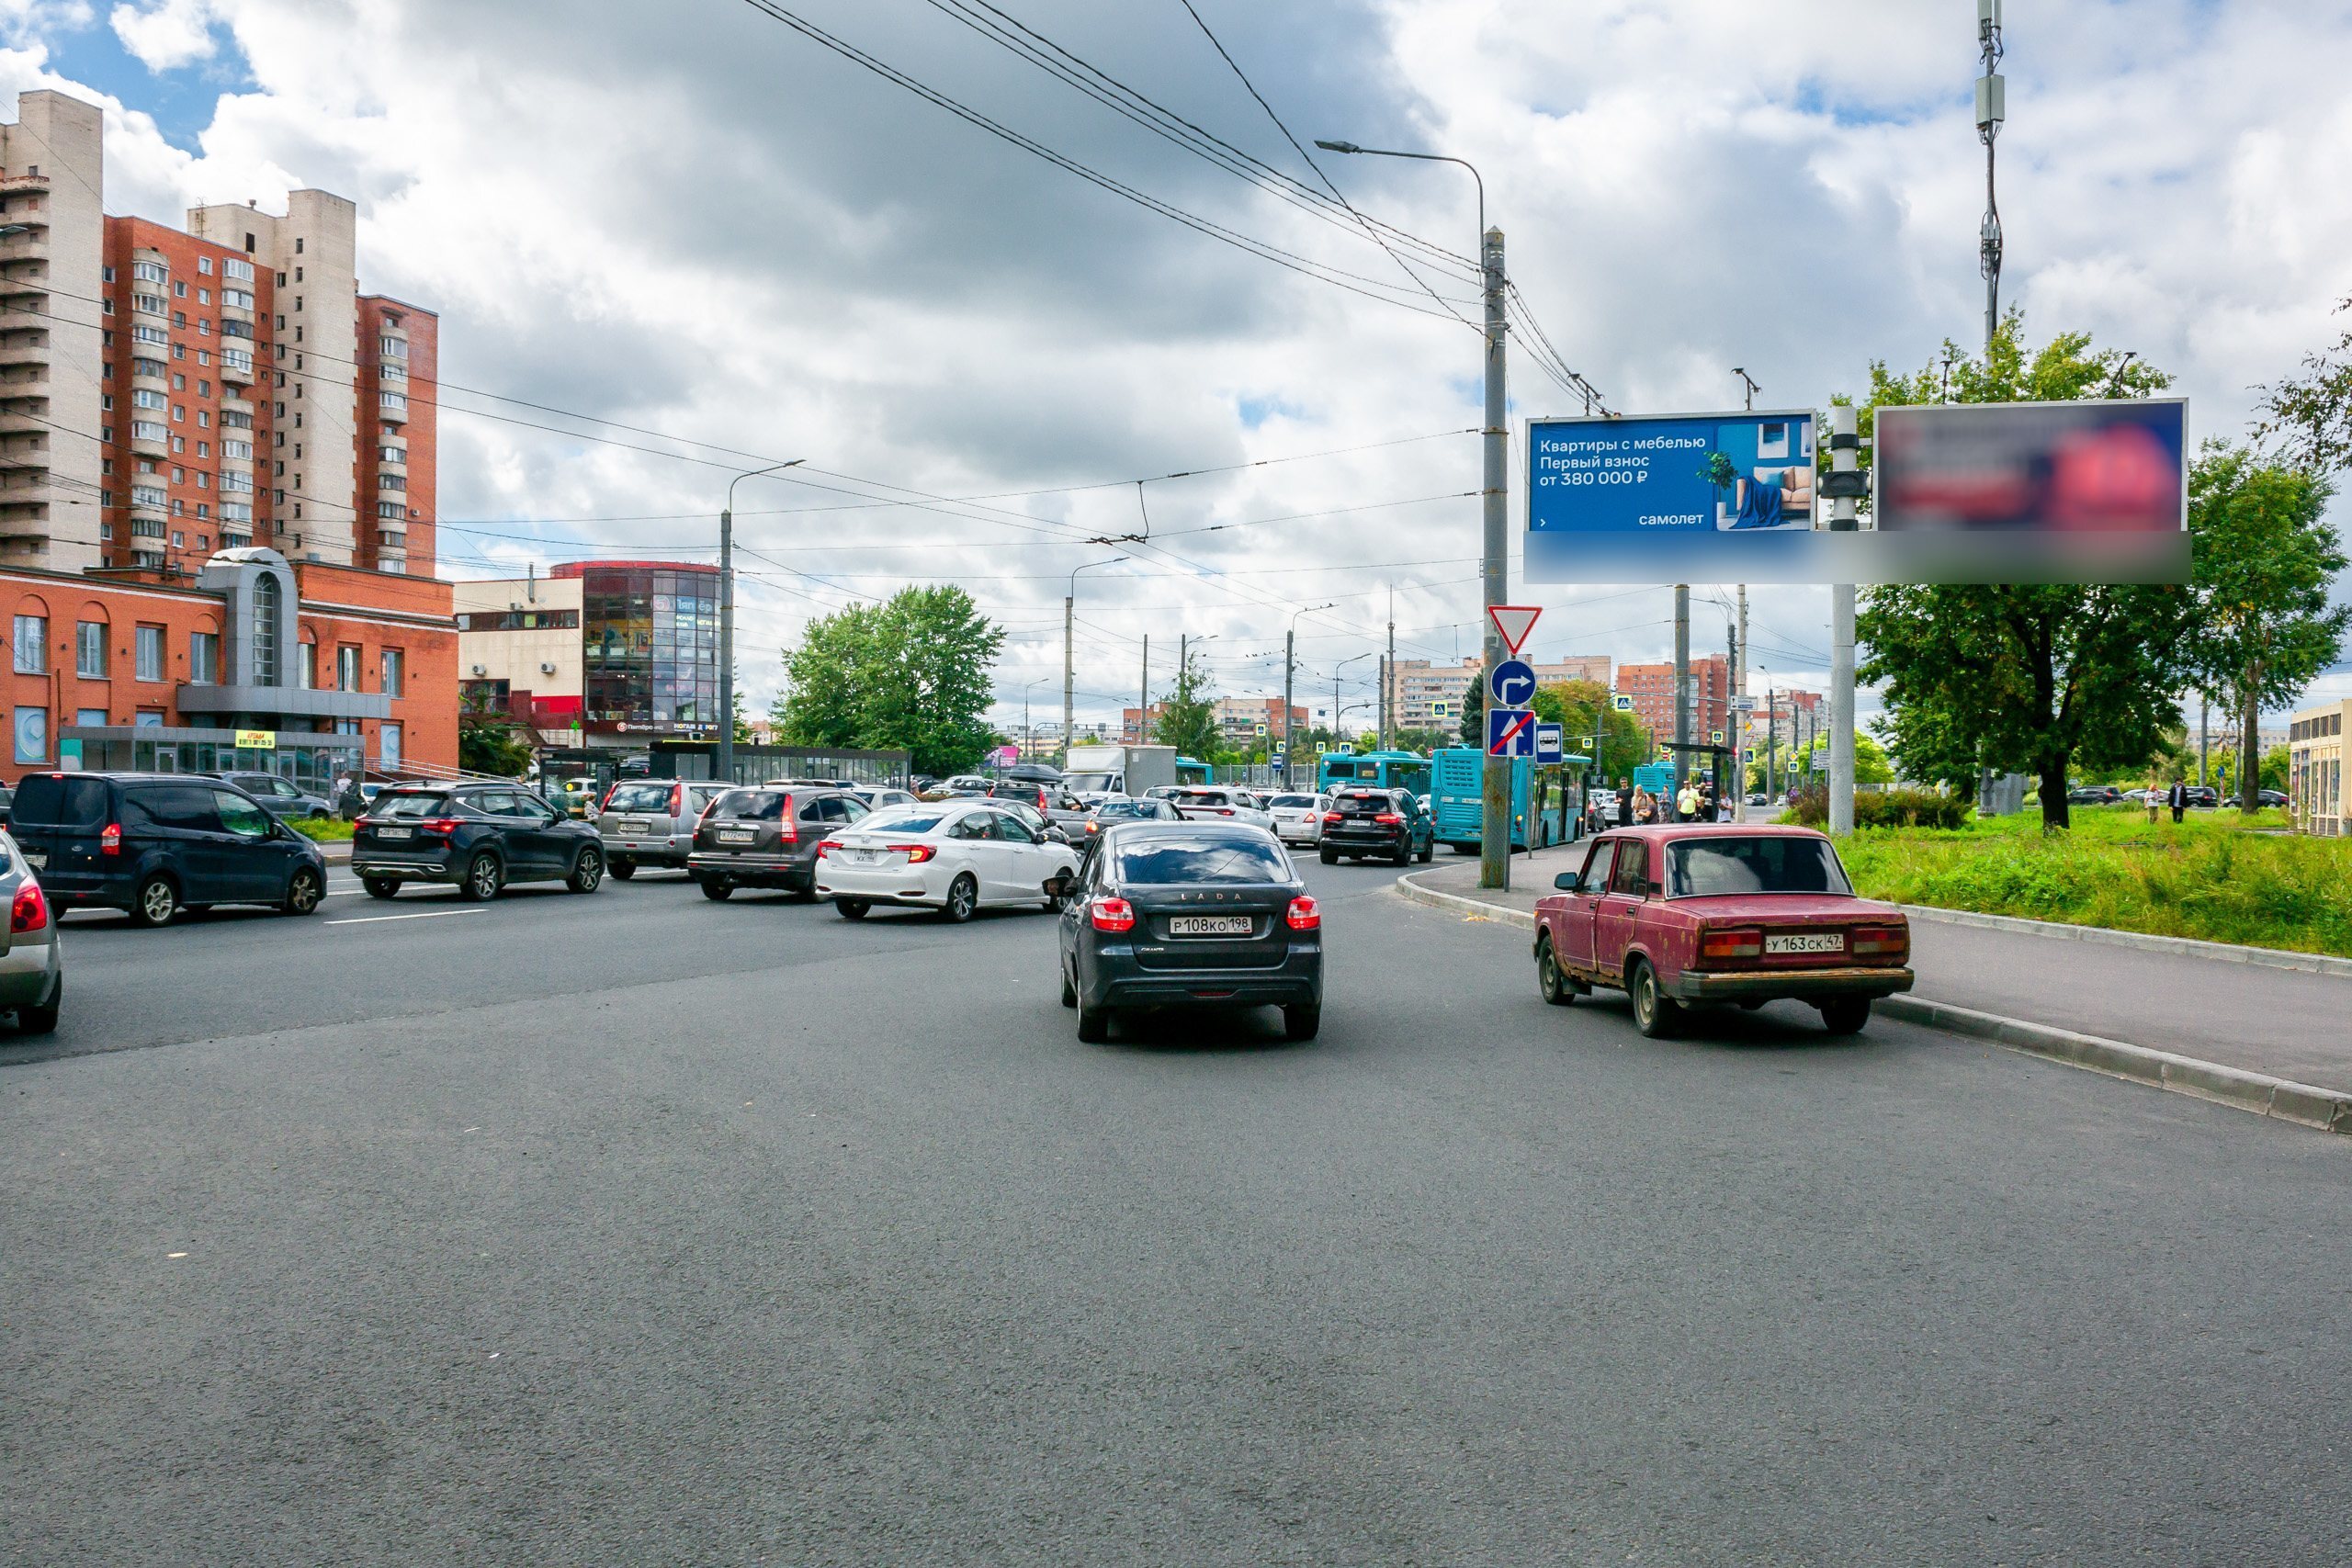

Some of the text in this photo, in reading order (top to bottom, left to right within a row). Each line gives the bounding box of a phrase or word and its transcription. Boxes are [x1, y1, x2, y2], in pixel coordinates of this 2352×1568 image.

[1540, 435, 1706, 455] Квартиры с мебелью
[1540, 456, 1650, 471] Первый взнос
[1540, 476, 1557, 486] от
[1561, 471, 1595, 486] 380
[1598, 471, 1633, 485] 000
[1639, 513, 1704, 525] самолет
[1228, 918, 1249, 928] 198
[1826, 935, 1839, 946] 47
